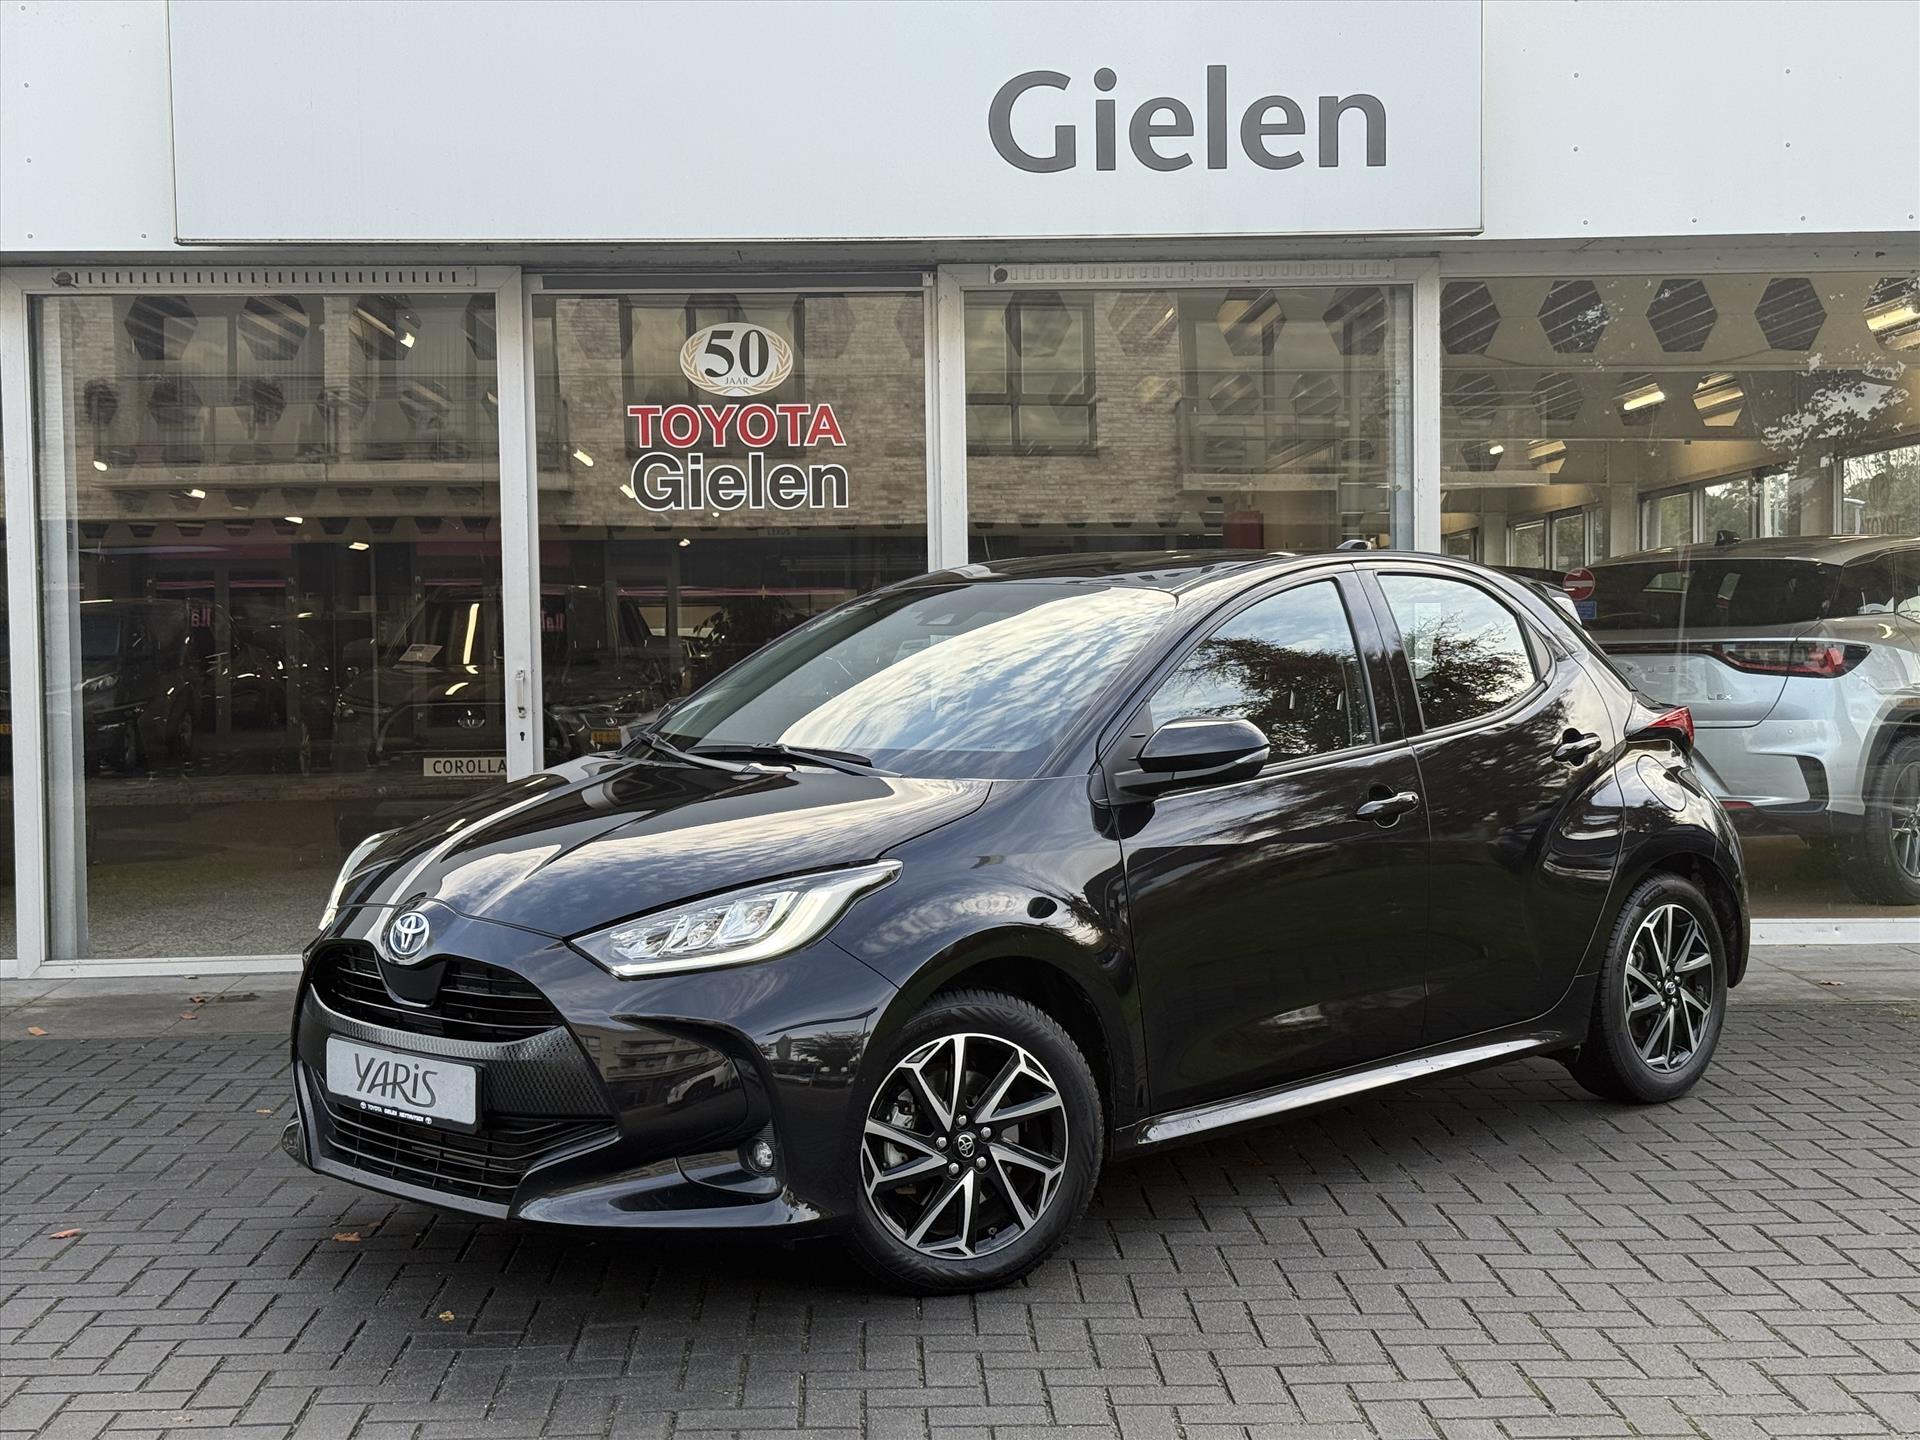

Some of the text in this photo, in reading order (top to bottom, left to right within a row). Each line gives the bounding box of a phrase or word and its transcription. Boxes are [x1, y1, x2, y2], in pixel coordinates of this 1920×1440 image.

[987, 64, 1387, 174] Gielen
[703, 328, 770, 378] 50
[723, 376, 750, 386] JAAR
[627, 403, 848, 449] TOYOTA
[630, 451, 849, 512] Gielen
[432, 759, 507, 774] COROLLA
